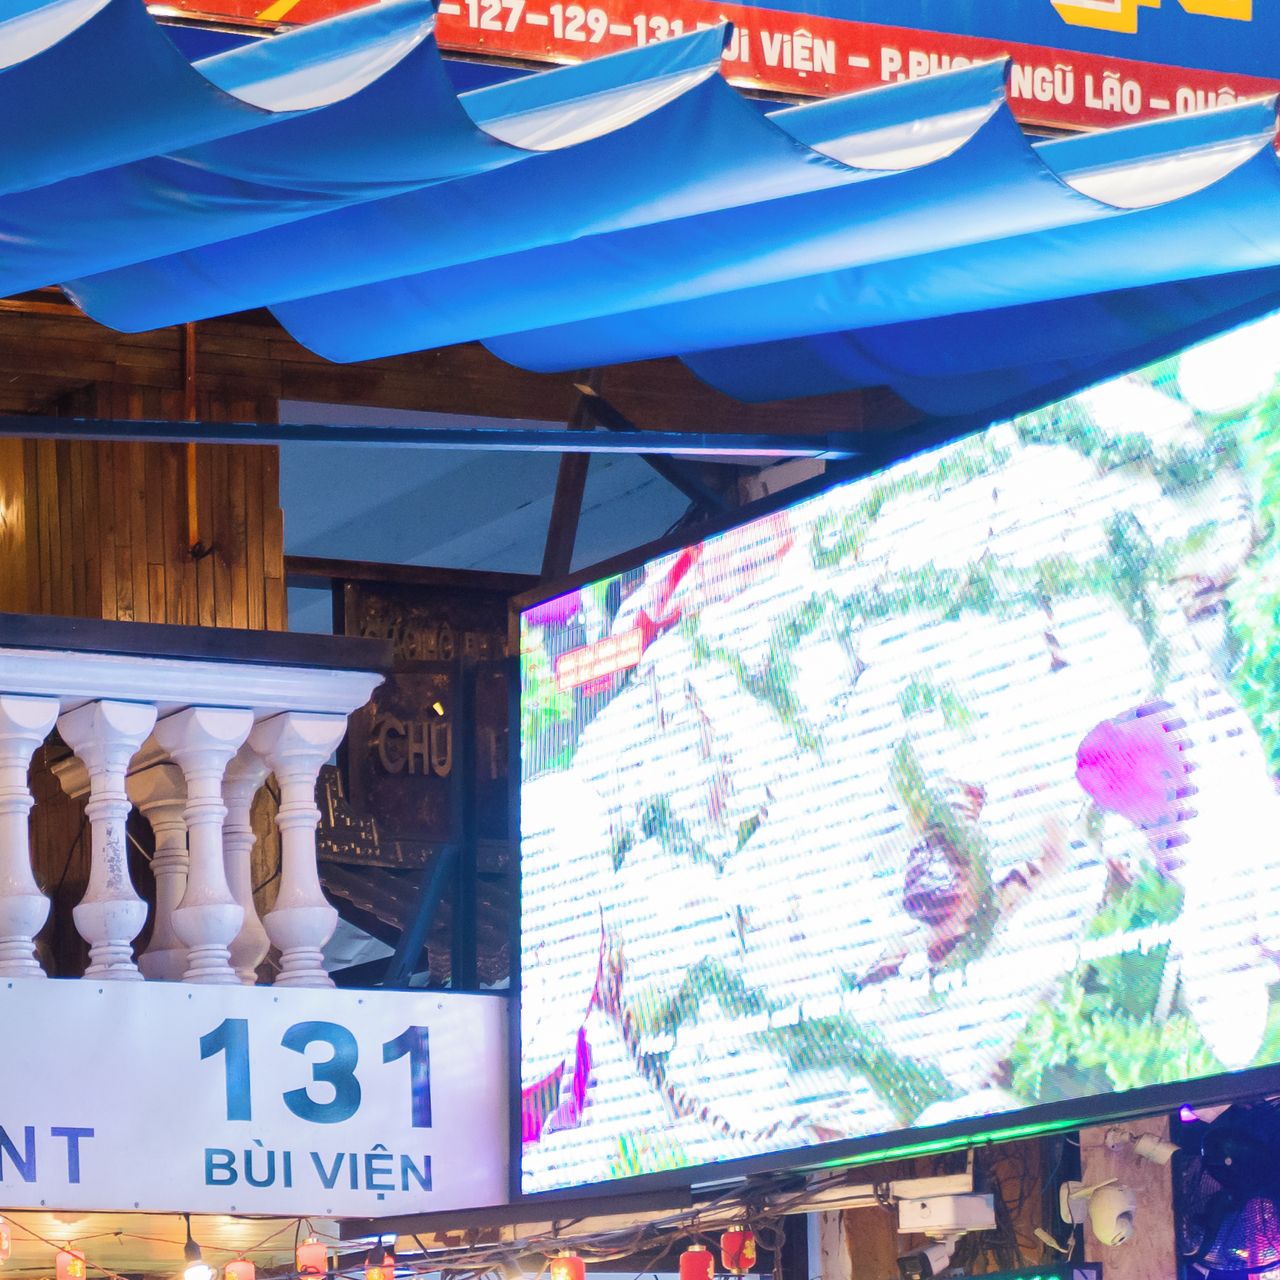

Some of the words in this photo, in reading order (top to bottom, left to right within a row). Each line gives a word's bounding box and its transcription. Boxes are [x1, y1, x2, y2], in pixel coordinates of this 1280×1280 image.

[760, 28, 837, 77] VIỆN
[1010, 63, 1075, 105] NGŨ
[1084, 71, 1142, 115] LÃO
[199, 1018, 434, 1130] 131
[203, 1146, 294, 1190] BÙI
[307, 1141, 434, 1195] VIỆN
